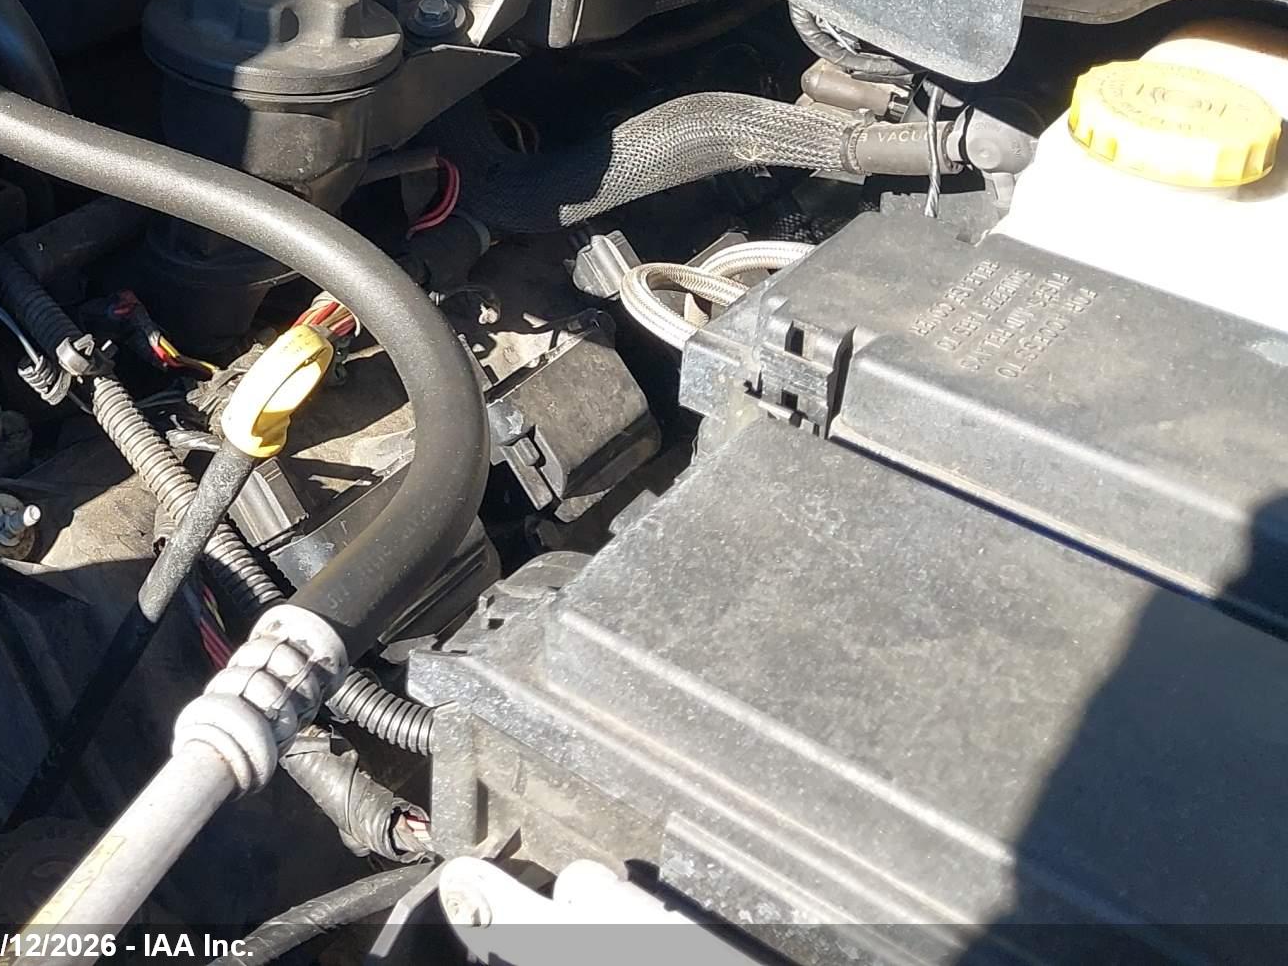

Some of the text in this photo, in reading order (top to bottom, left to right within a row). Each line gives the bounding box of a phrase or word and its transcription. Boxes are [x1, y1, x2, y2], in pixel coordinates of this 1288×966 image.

[943, 259, 1002, 306] RELEASE
[1062, 286, 1098, 314] FOR
[934, 335, 963, 352] TO
[995, 360, 1027, 379] TO
